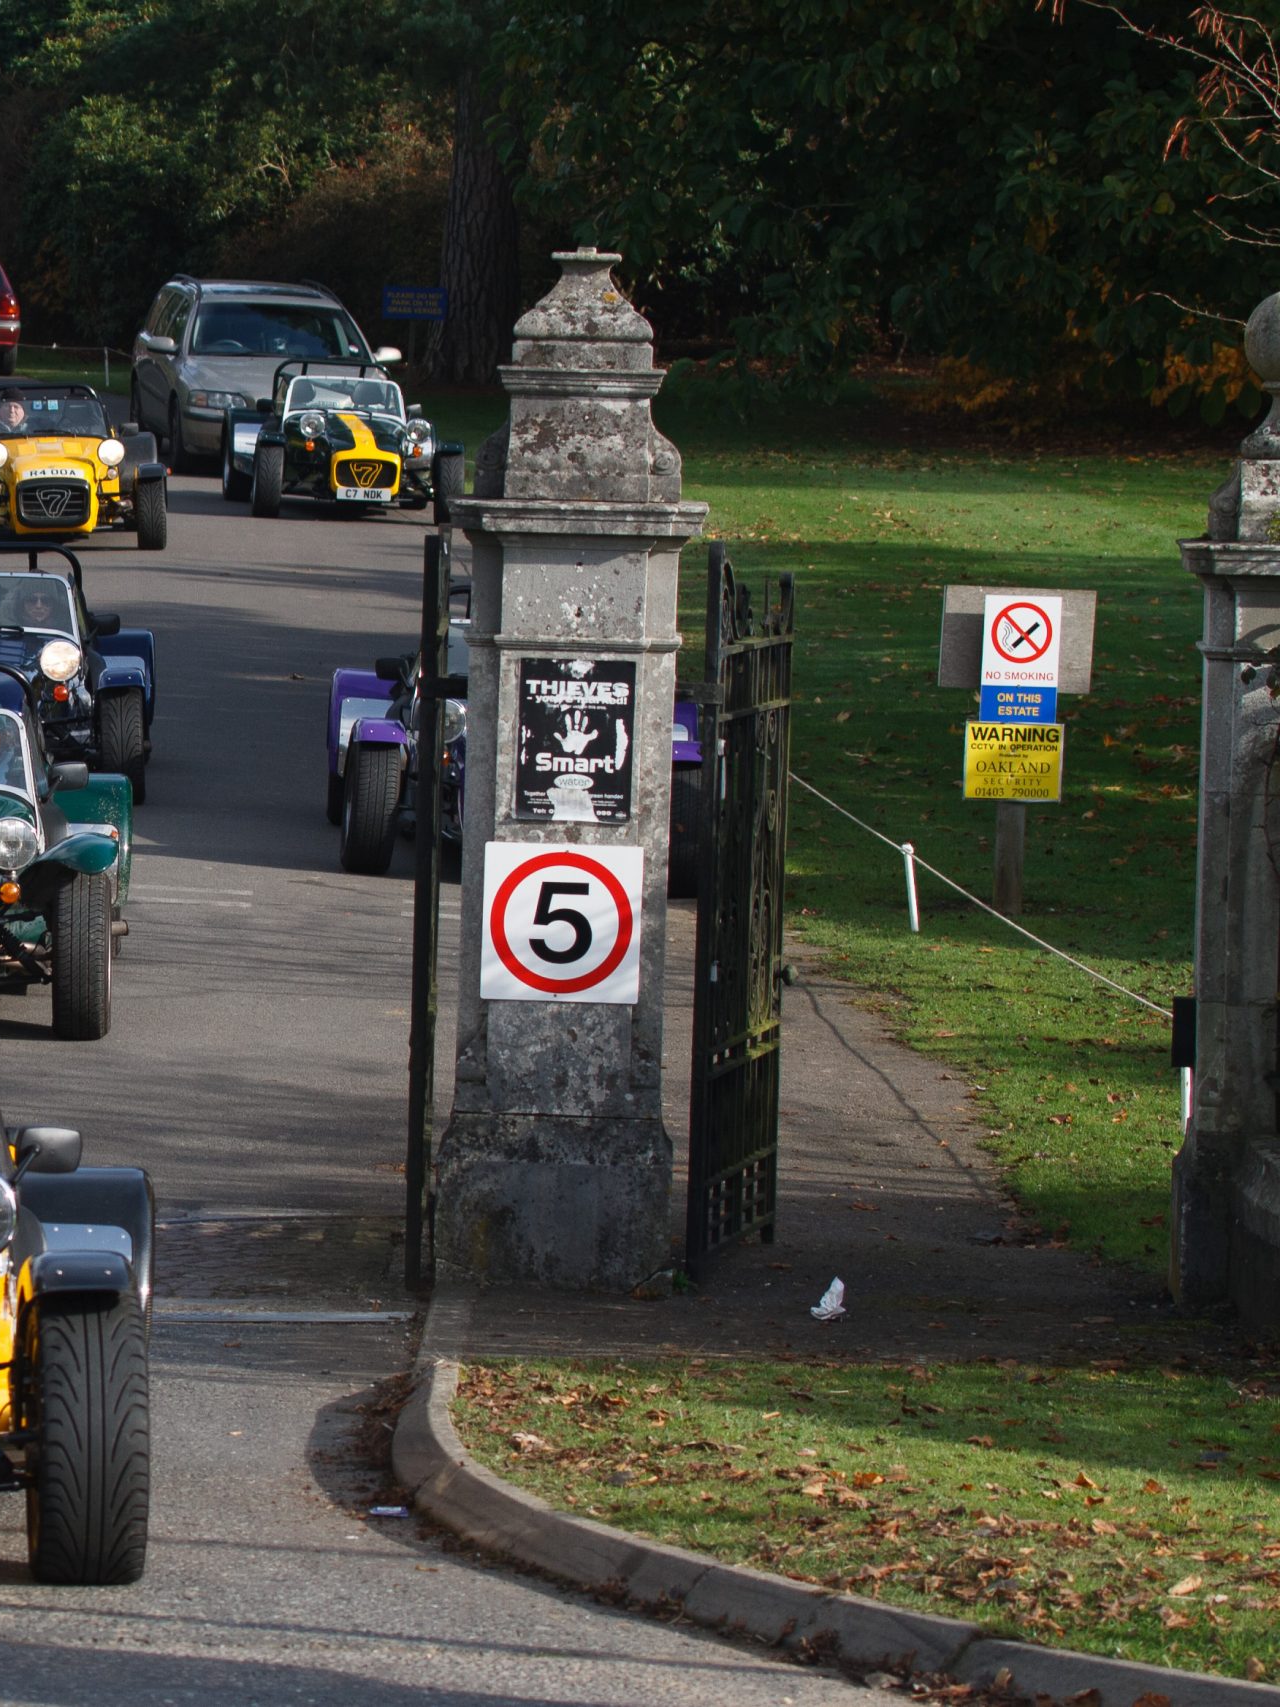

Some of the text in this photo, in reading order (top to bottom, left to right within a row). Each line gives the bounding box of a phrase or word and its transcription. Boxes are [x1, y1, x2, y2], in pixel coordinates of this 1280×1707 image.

[345, 489, 358, 498] C7
[985, 671, 1054, 681] NO SMOKING
[525, 679, 630, 698] THIEVES
[997, 692, 1042, 704] ON THIS
[997, 706, 1040, 717] ESTATE
[971, 726, 1060, 743] WARNING
[971, 742, 1058, 752] CCTV IN OPERATION
[535, 752, 614, 774] Smart
[976, 760, 1051, 774] OAKLAND
[559, 778, 590, 787] water
[983, 777, 1042, 786] SECURITY
[975, 787, 1049, 798] 01403 790000
[529, 881, 593, 964] 5
